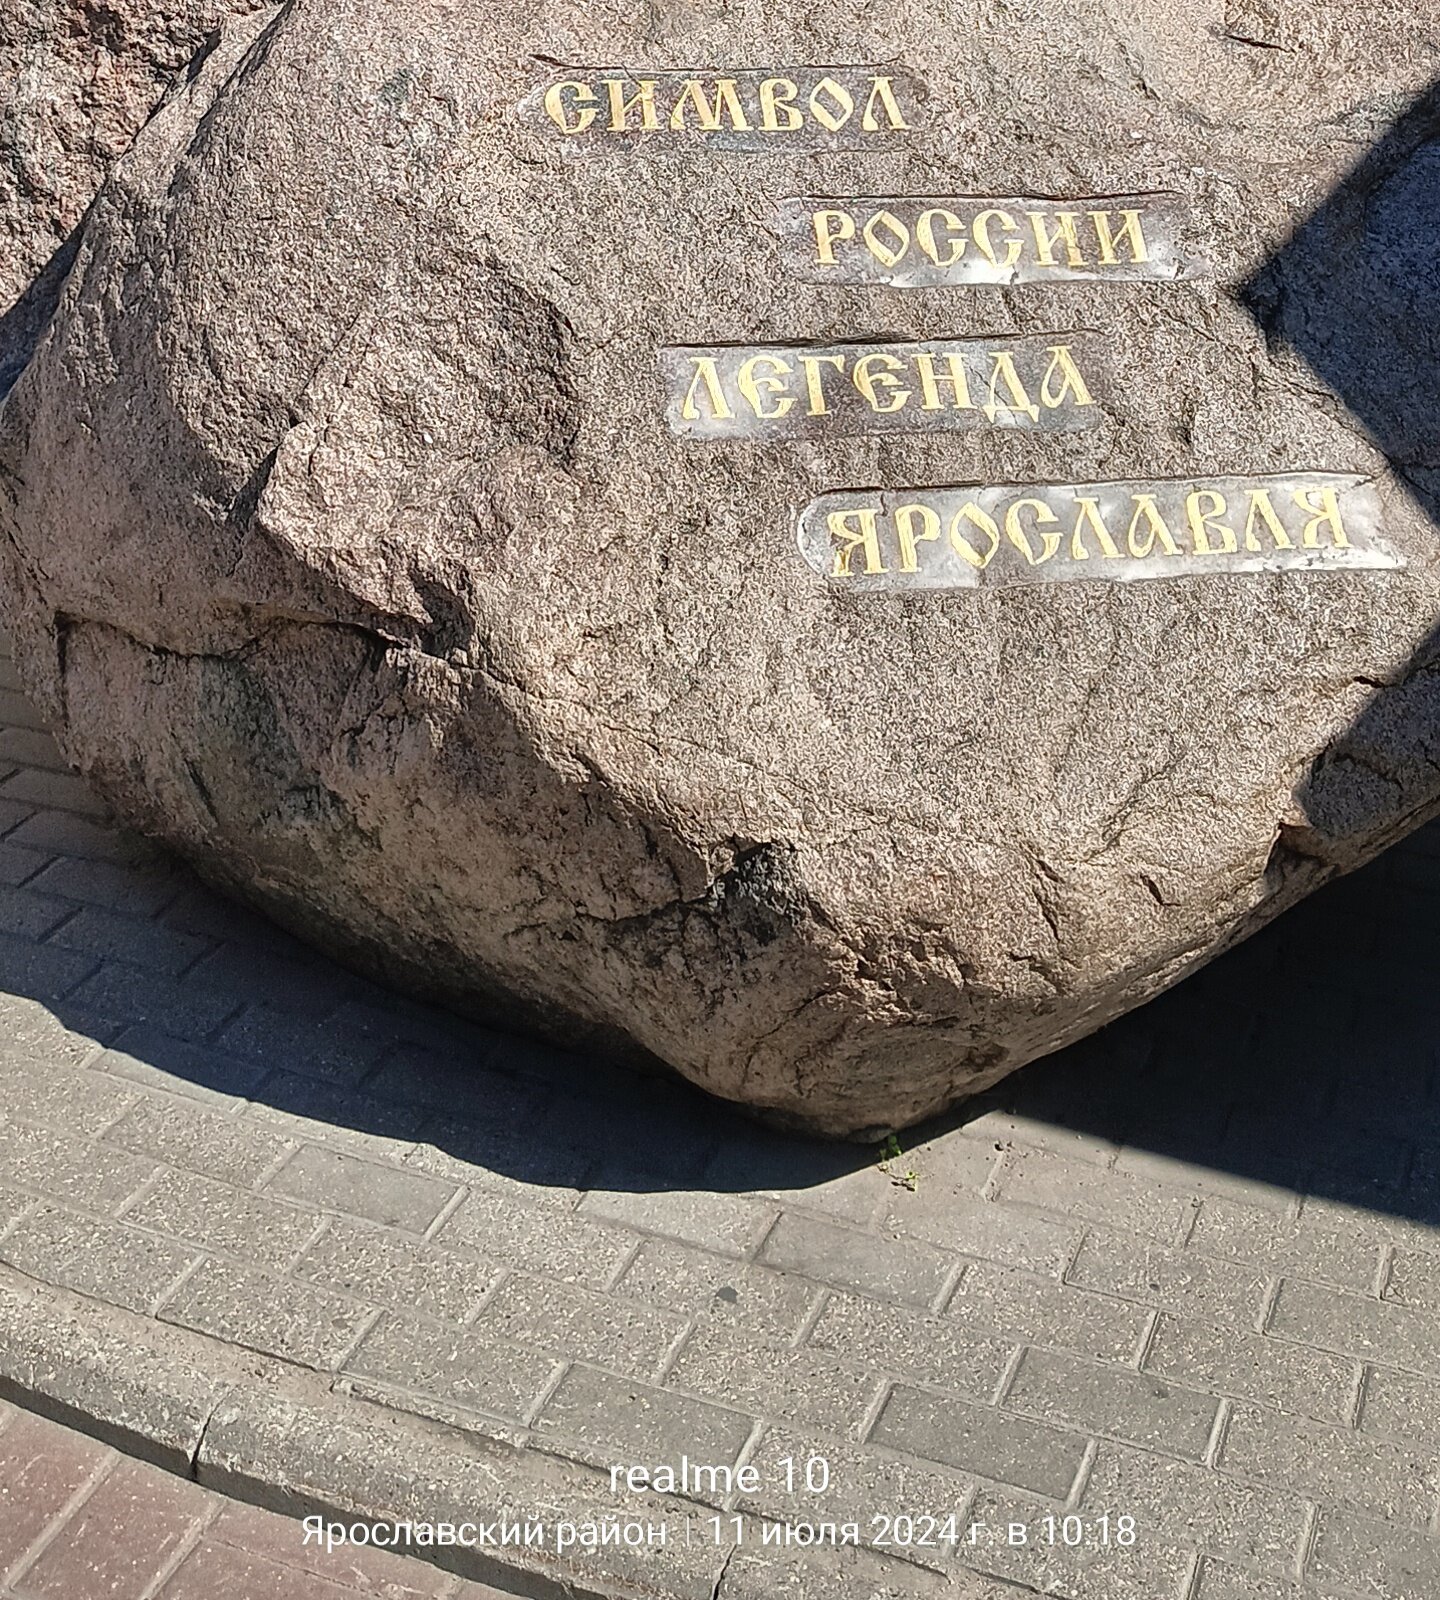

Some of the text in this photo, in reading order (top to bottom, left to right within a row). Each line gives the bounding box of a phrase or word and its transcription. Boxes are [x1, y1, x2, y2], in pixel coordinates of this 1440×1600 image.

[545, 76, 911, 135] СИМВОЛ
[812, 207, 1151, 268] РОССИИ
[680, 344, 1096, 424] ЛЕГЕНДА
[827, 486, 1354, 578] ЯРОСЛАВЛЯ
